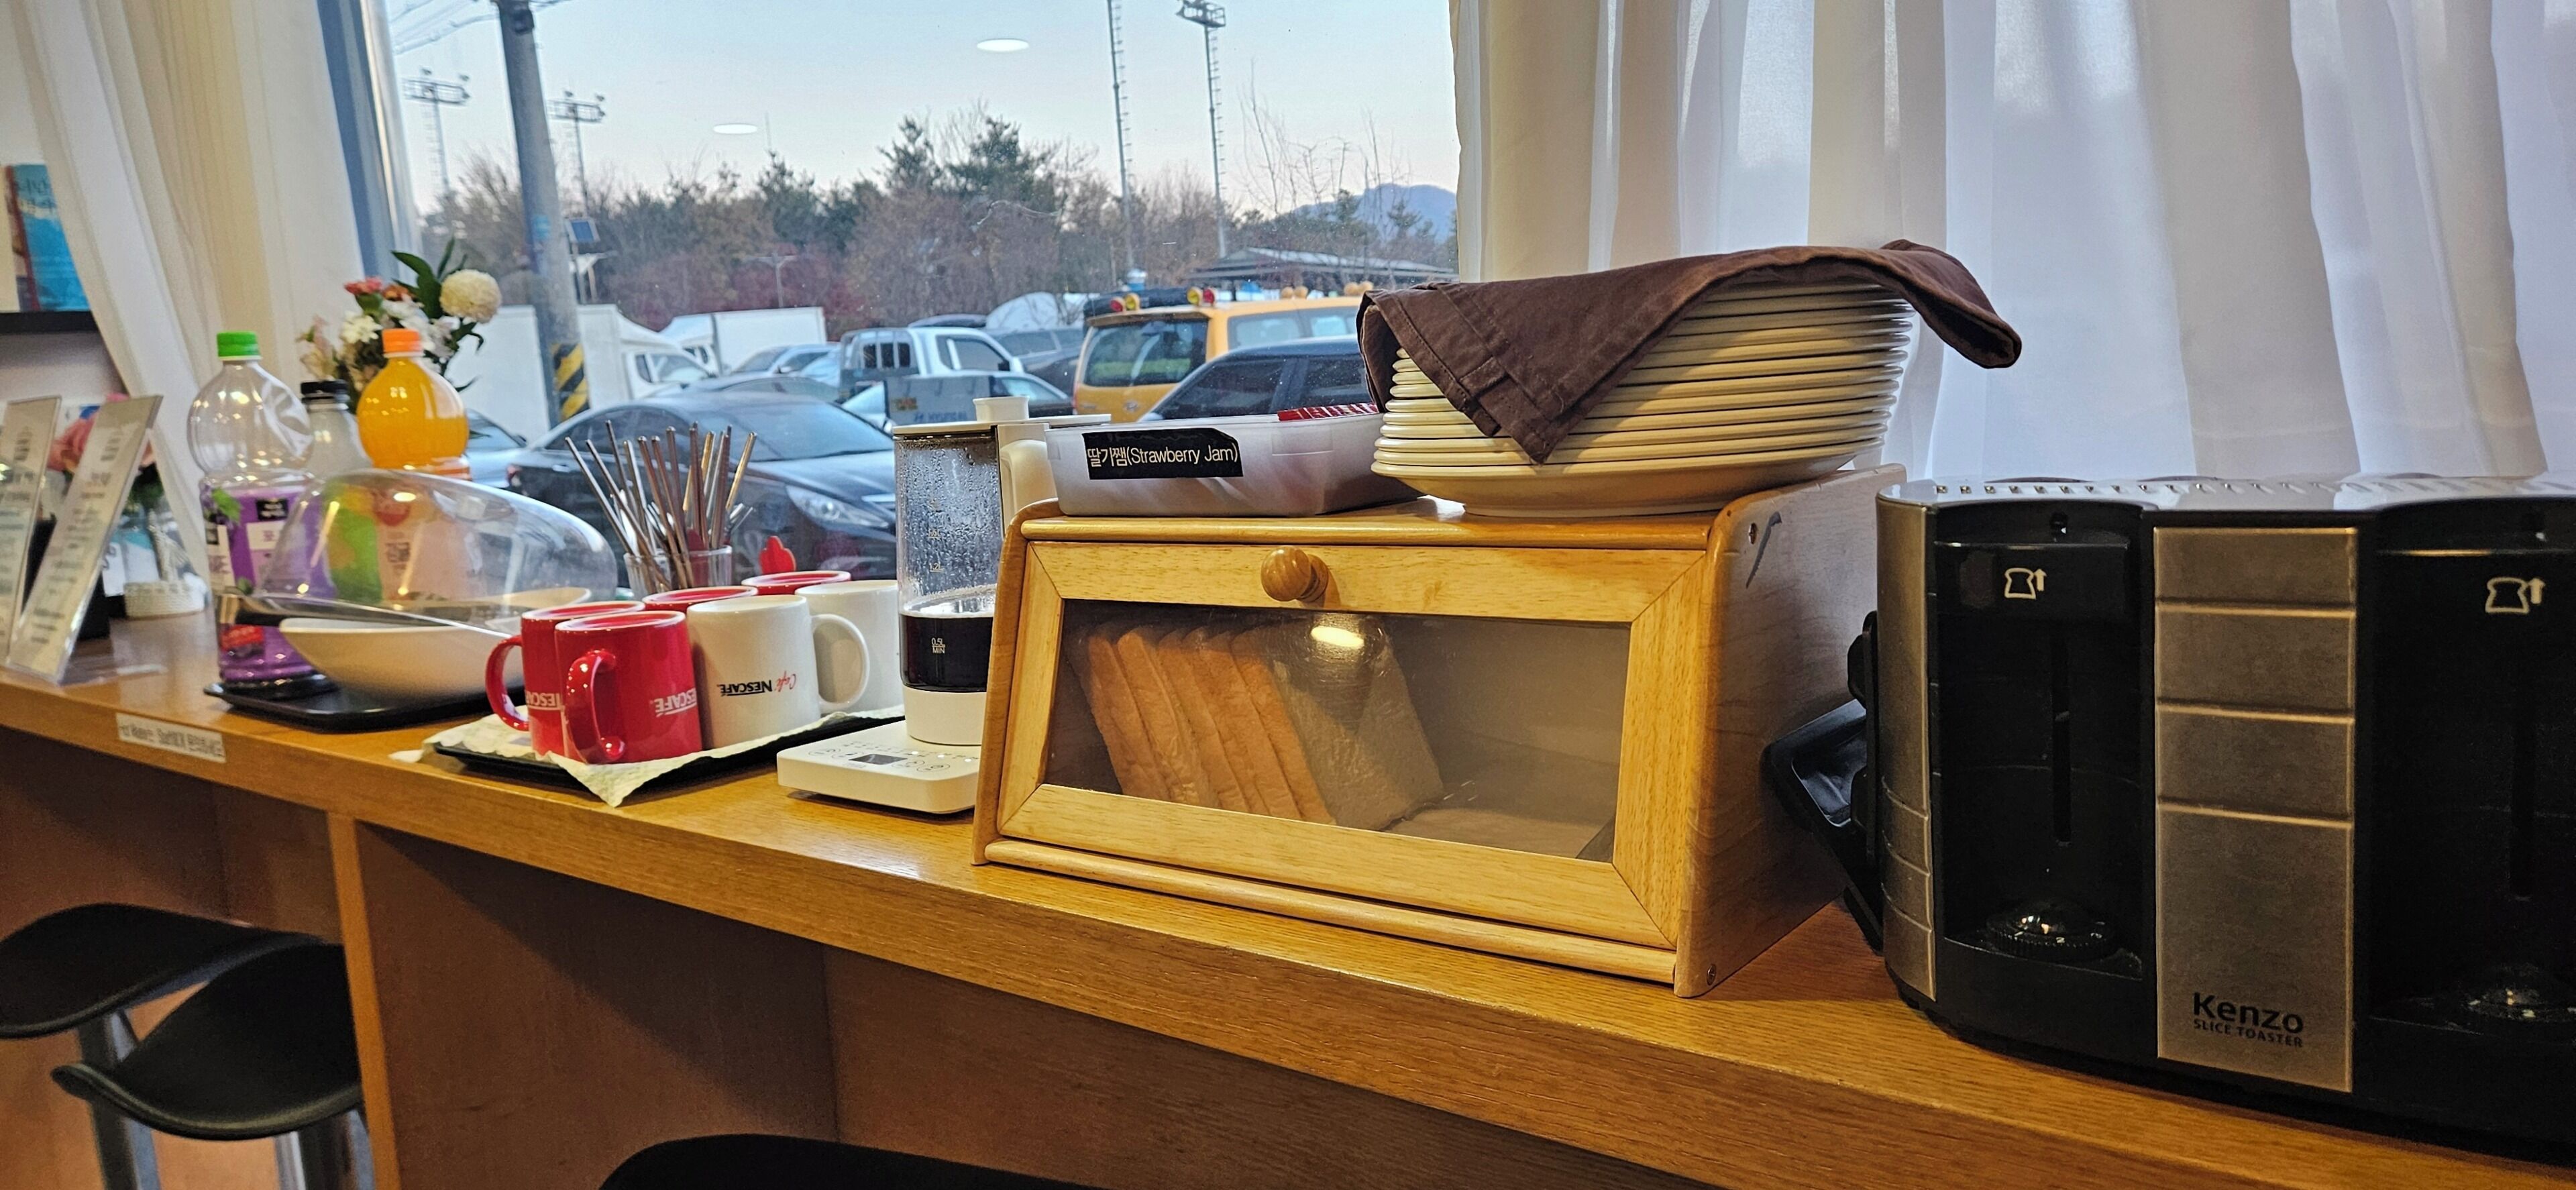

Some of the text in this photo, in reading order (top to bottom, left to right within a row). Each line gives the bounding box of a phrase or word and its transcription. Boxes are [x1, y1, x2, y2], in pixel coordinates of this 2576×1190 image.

[1204, 443, 1238, 463] Jam)
[2193, 991, 2304, 1034] Kenzo
[2193, 1018, 2304, 1048] SLICE TOASTER
